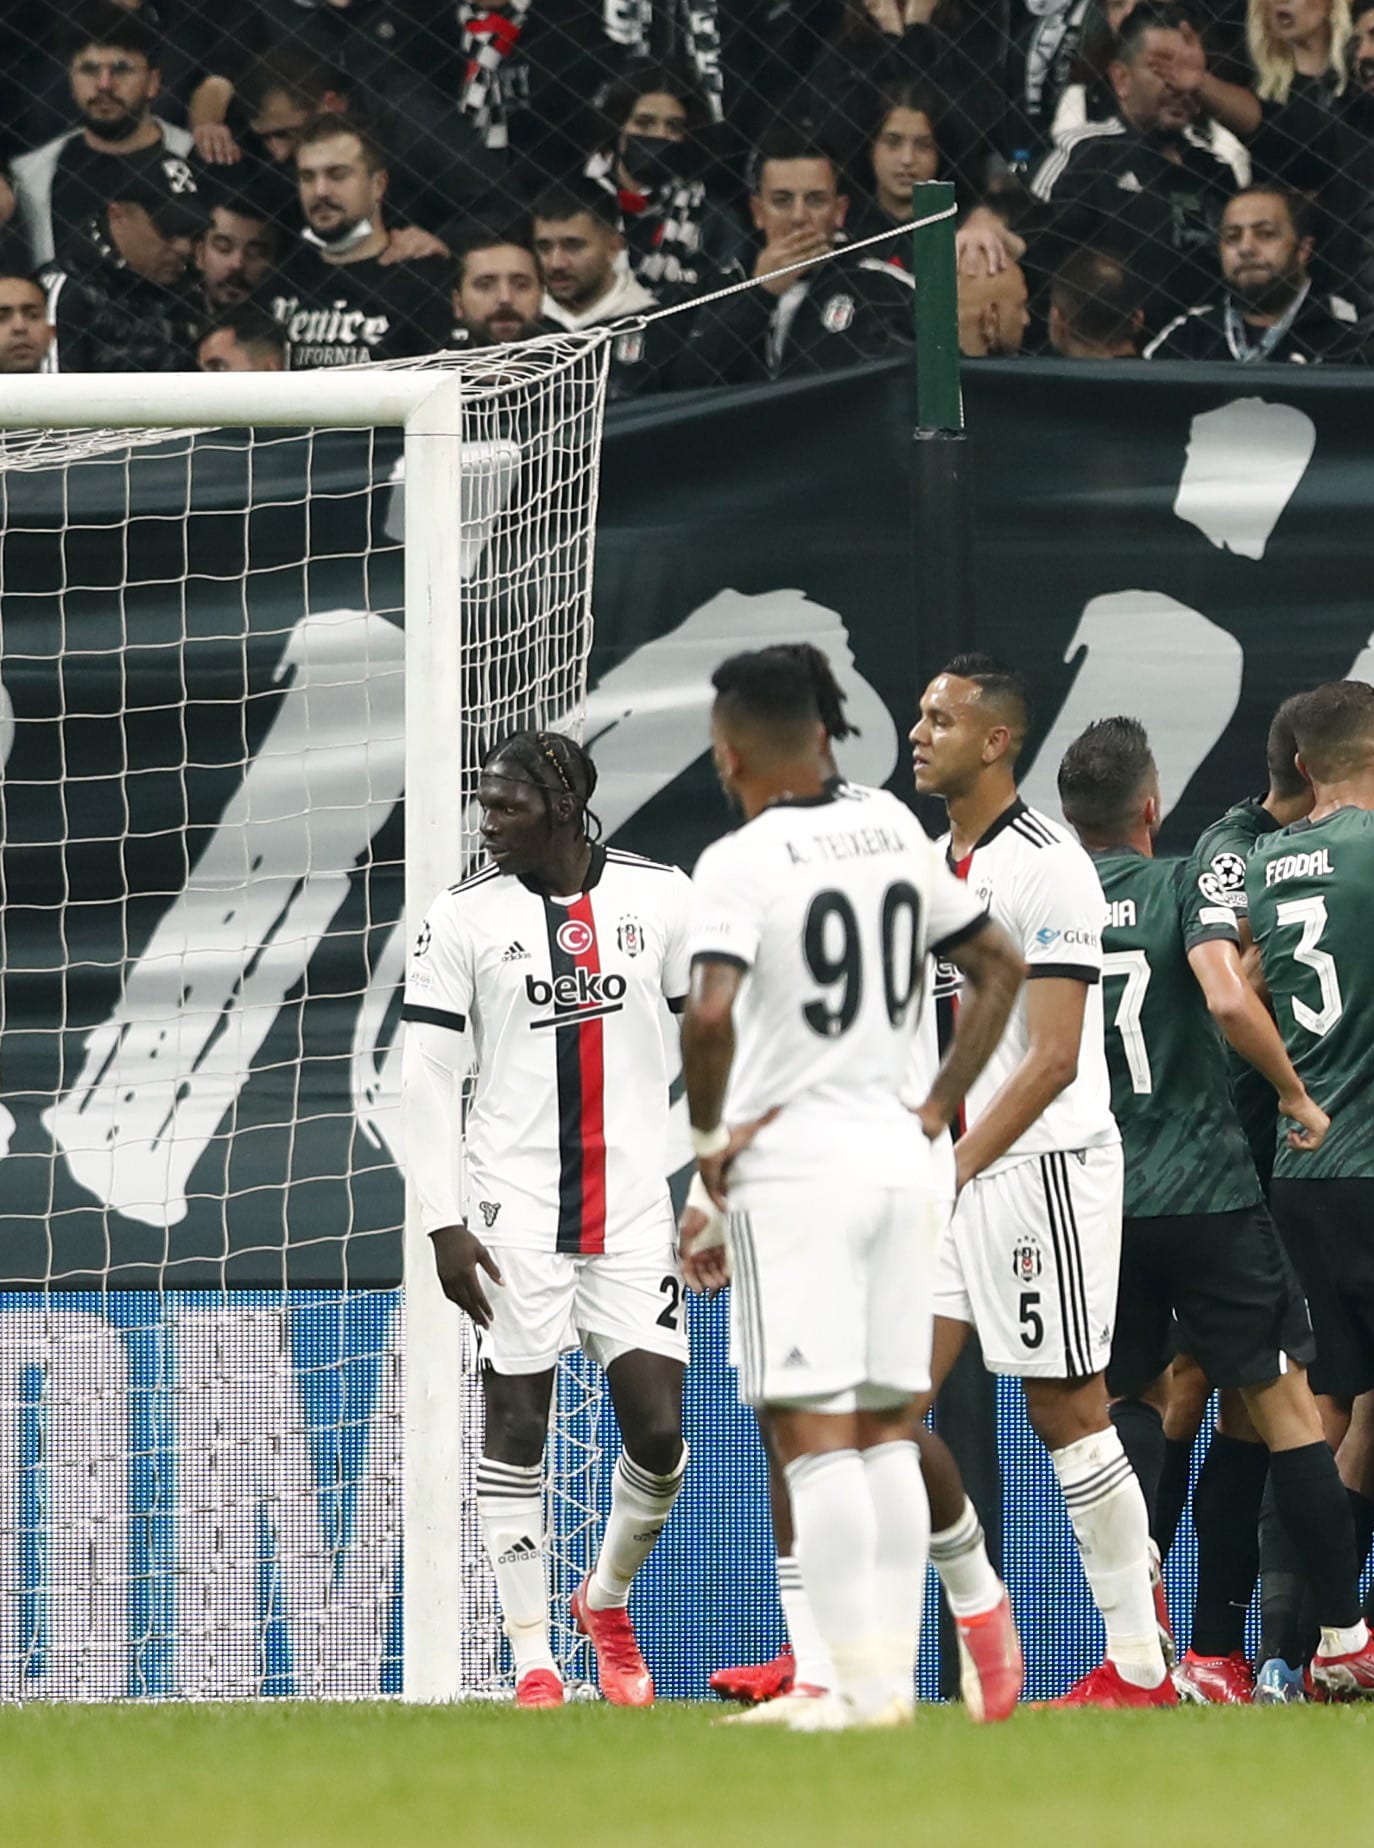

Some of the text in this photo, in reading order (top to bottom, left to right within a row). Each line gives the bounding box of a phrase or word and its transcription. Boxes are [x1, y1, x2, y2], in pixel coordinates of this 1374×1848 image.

[1266, 848, 1334, 888] FEDDAL
[525, 967, 627, 1006] beko
[802, 879, 922, 1039] 90
[1276, 895, 1343, 1036] 3
[1019, 1292, 1044, 1349] 5
